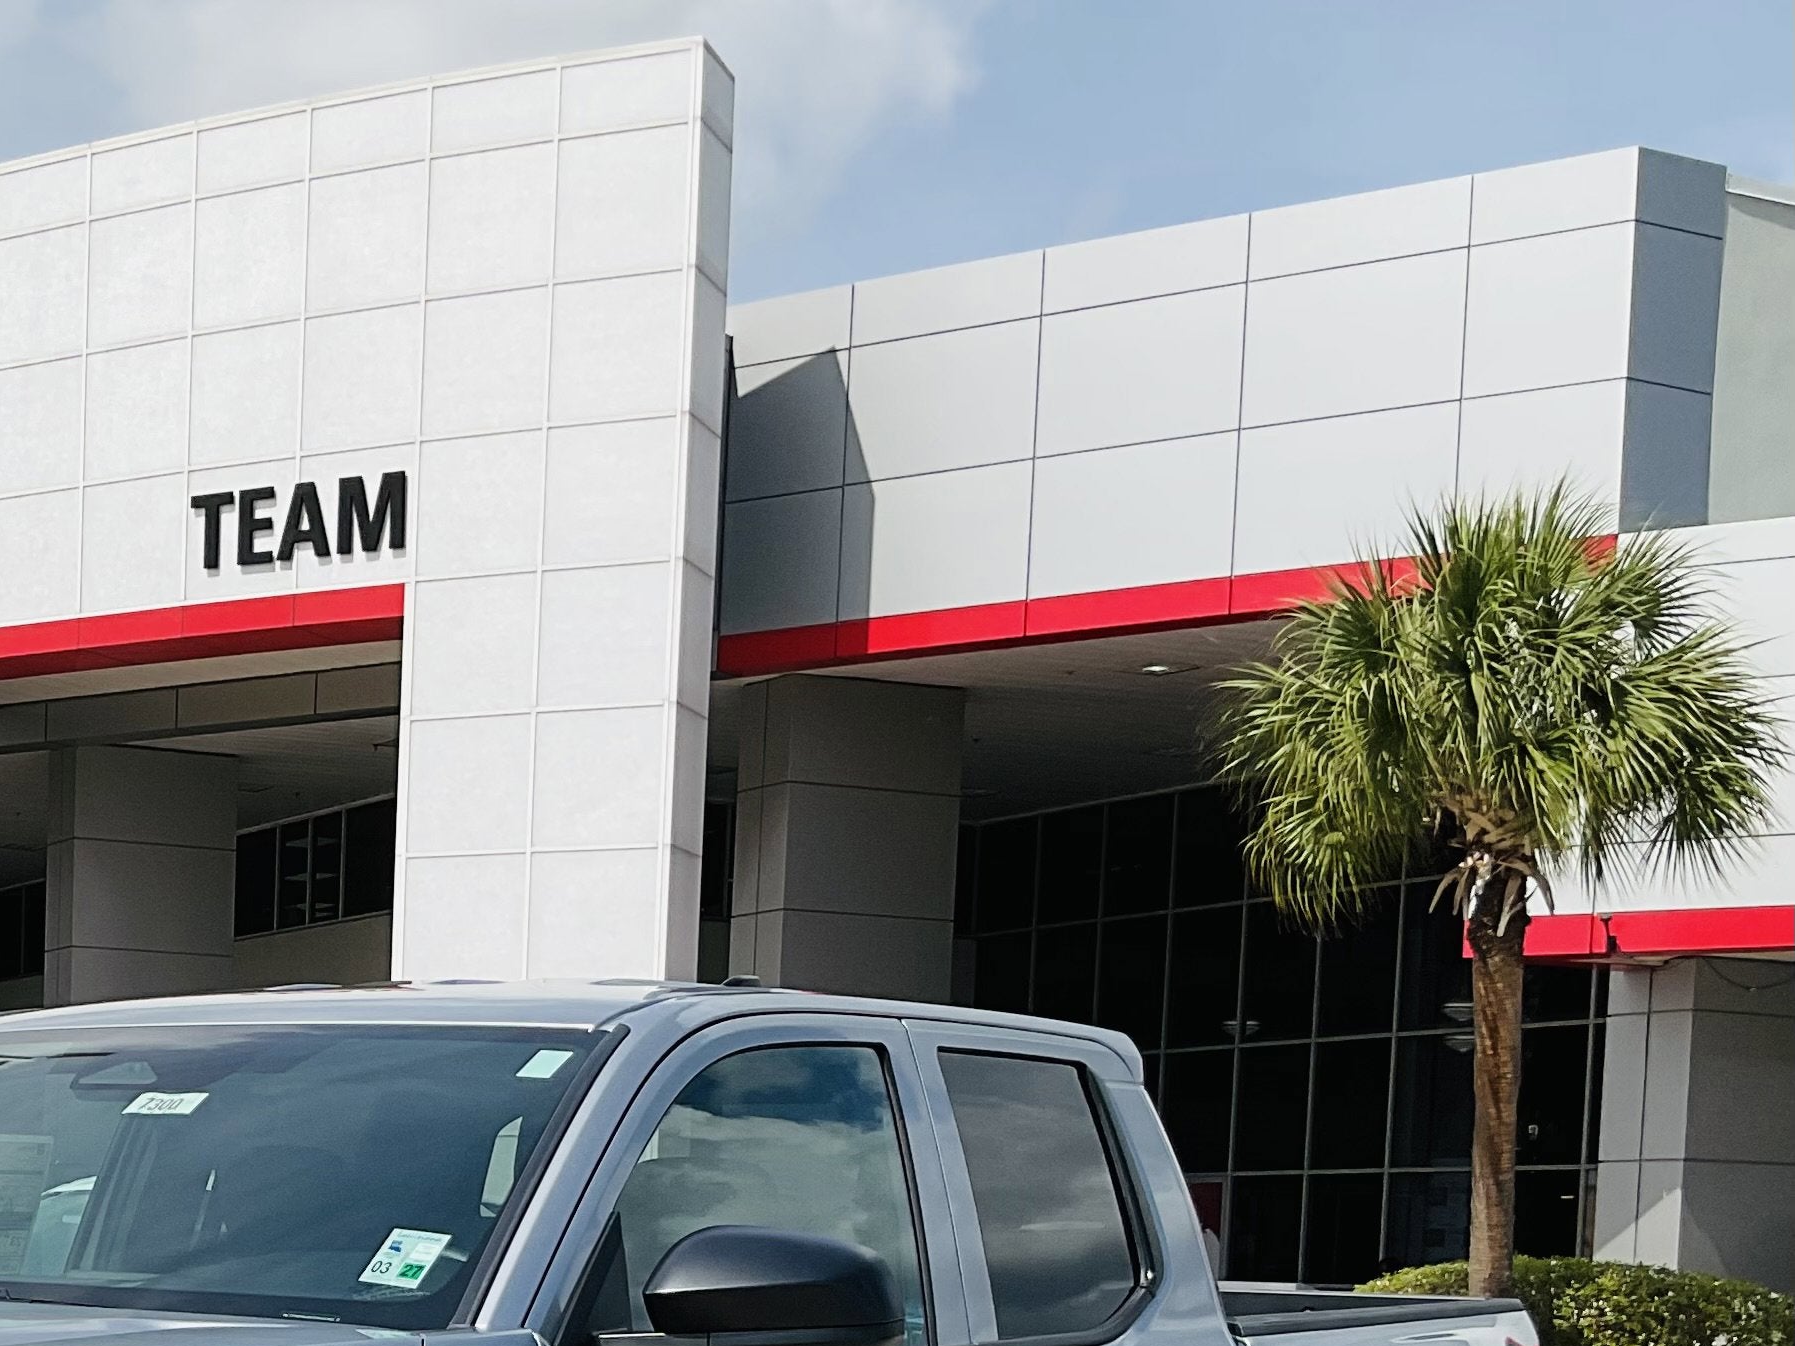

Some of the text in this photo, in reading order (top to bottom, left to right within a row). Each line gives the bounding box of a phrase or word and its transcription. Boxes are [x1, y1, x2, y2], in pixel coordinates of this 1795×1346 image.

[191, 471, 405, 569] TEAM
[371, 1260, 426, 1278] 03 27
